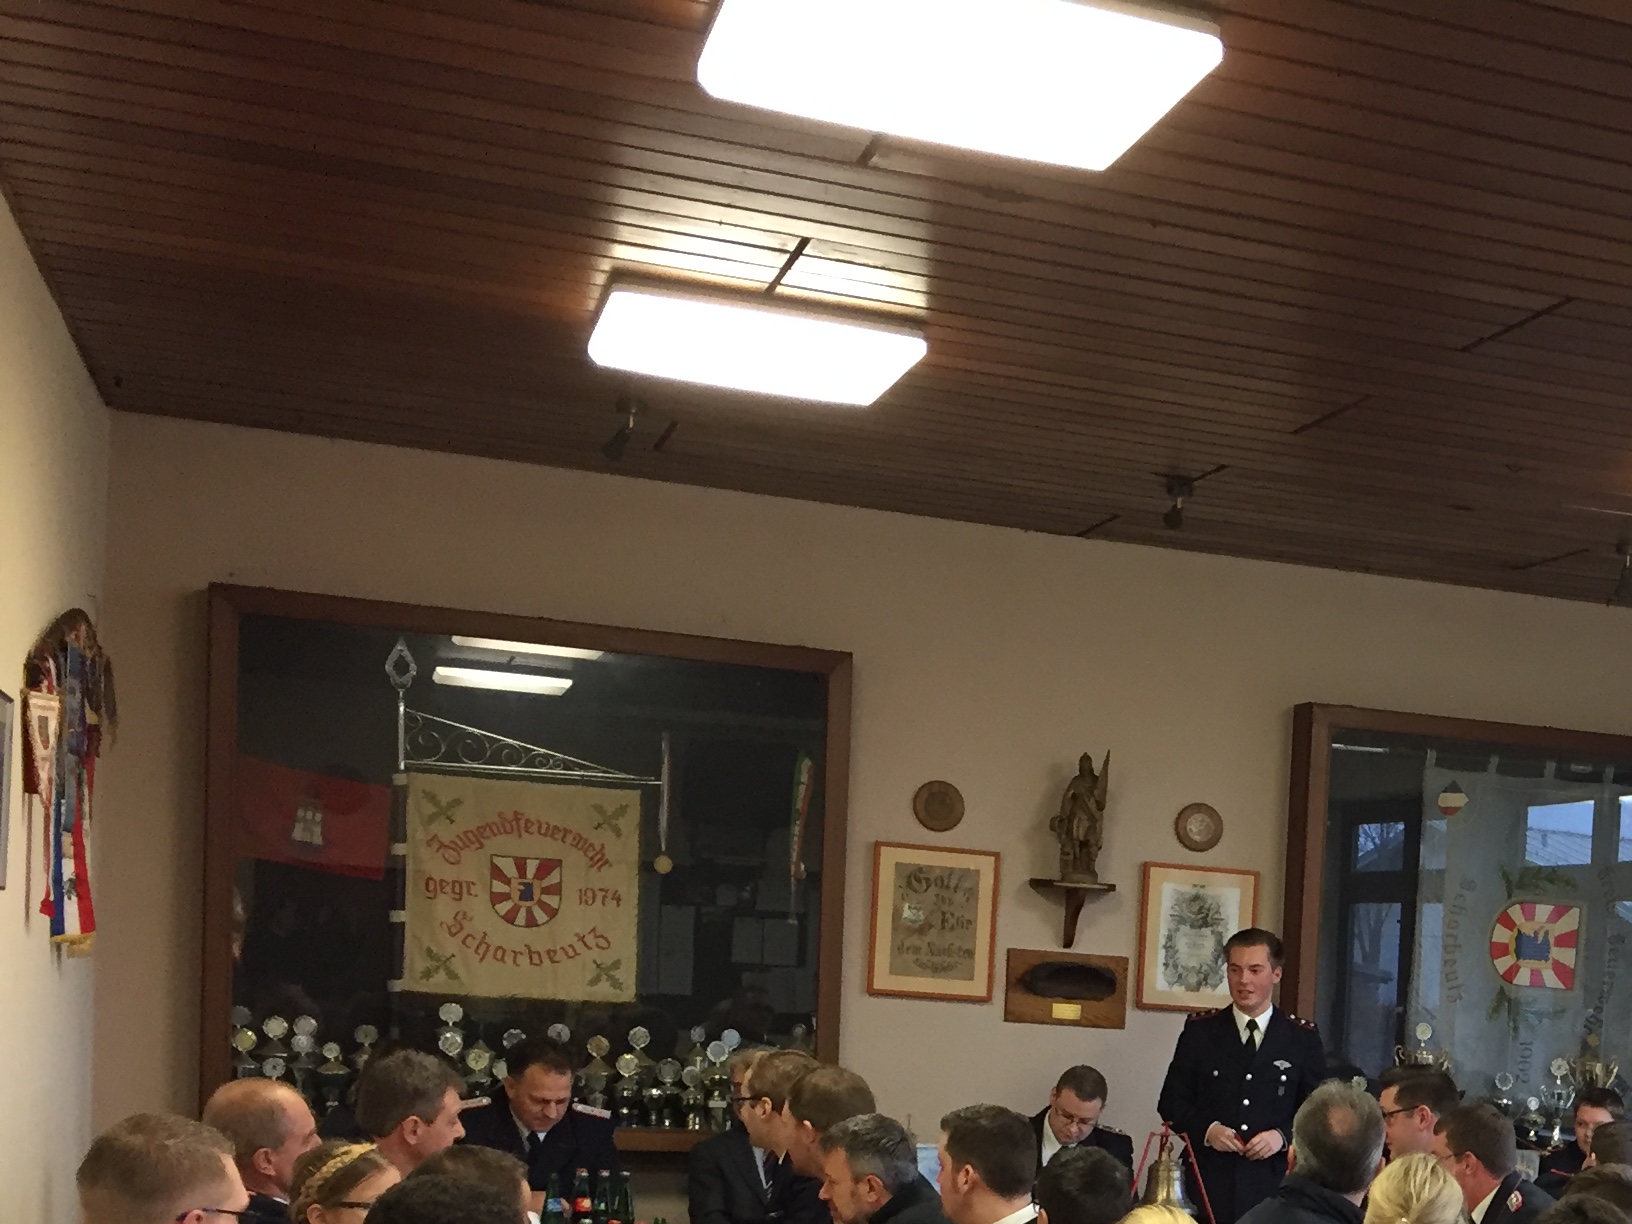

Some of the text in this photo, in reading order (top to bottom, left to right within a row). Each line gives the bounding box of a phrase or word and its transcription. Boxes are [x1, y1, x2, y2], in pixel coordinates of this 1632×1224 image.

[425, 809, 613, 873] Jugendfeuerwehr
[424, 874, 623, 908] gegr. 1974
[439, 909, 612, 968] Scharbeutz
[1443, 875, 1478, 1004] Scharbeutz
